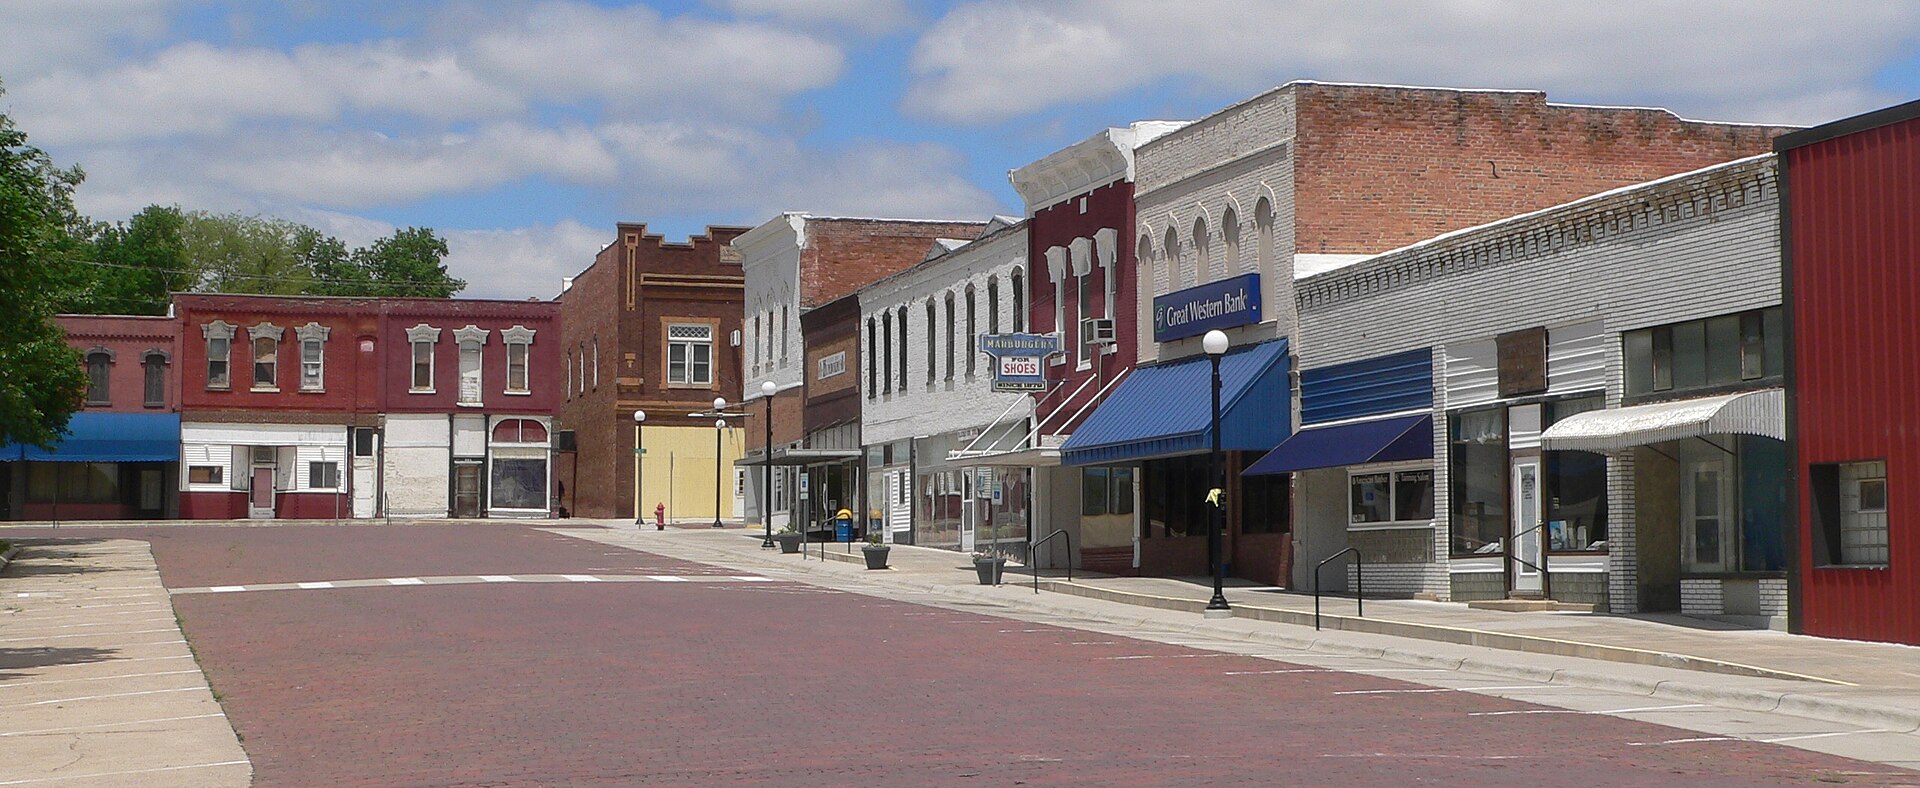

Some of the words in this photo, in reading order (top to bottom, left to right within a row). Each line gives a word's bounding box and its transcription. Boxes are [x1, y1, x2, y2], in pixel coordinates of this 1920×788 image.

[1166, 304, 1189, 327] Great
[1189, 299, 1223, 322] Western
[1224, 288, 1246, 314] Bank
[1004, 363, 1036, 374] SHOES
